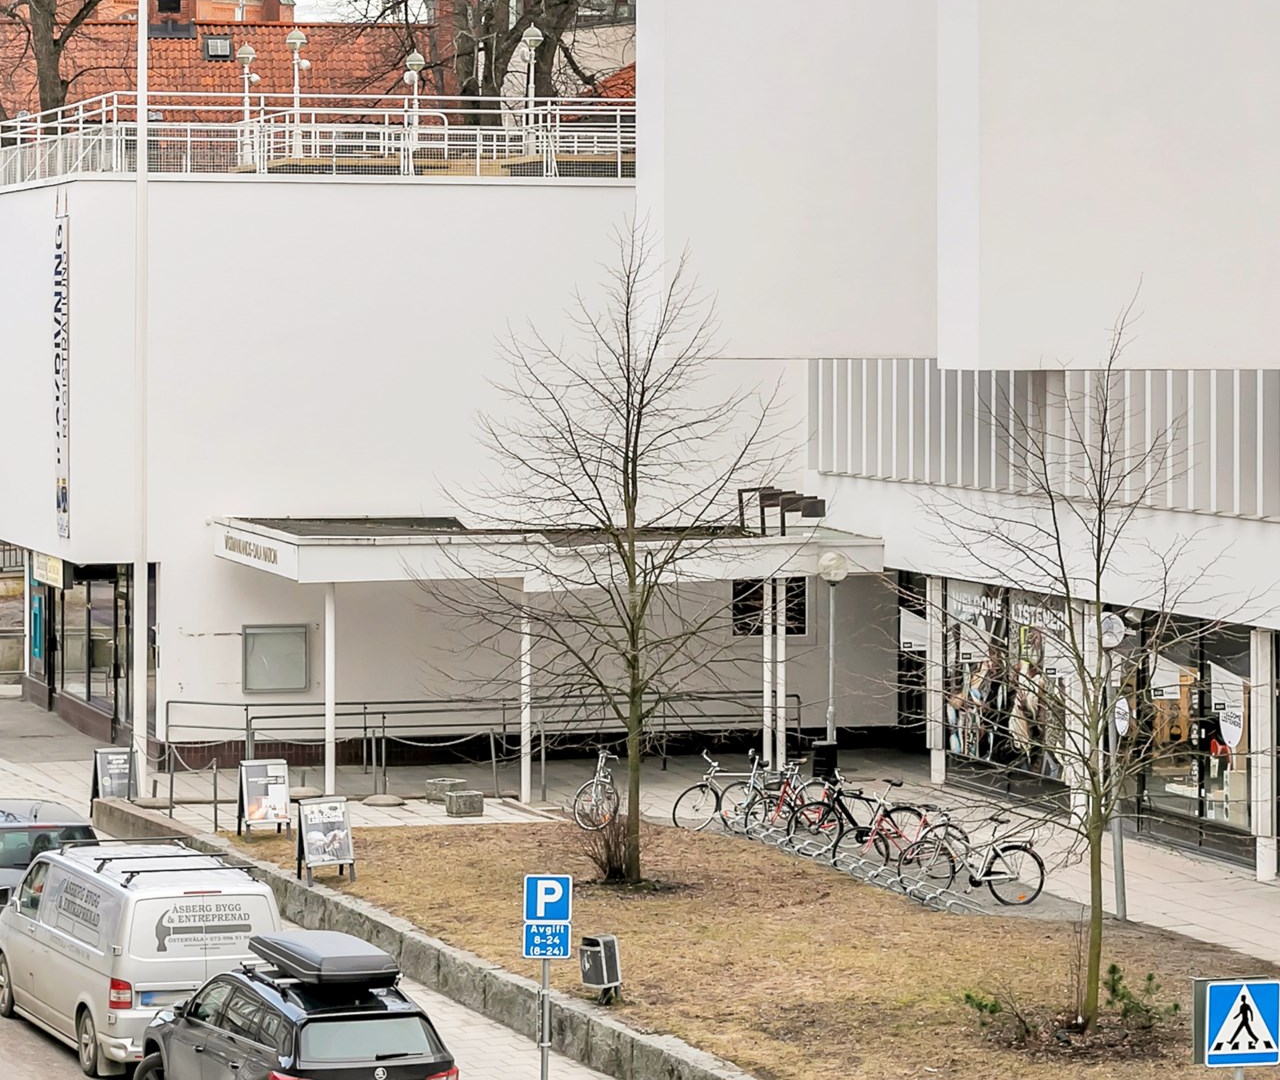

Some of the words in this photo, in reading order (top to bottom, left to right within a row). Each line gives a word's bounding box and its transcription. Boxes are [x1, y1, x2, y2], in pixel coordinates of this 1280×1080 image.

[952, 592, 1002, 619] WELCOME
[1011, 603, 1065, 631] LISTENER
[536, 879, 564, 918] P
[172, 903, 213, 914] ÅSBERG
[215, 903, 242, 912] BYGG
[167, 915, 175, 924] &
[178, 913, 251, 924] ENTREPRENAD
[530, 924, 564, 935] Avgift
[533, 935, 560, 945] 8-24
[529, 946, 564, 956] (8-24)
